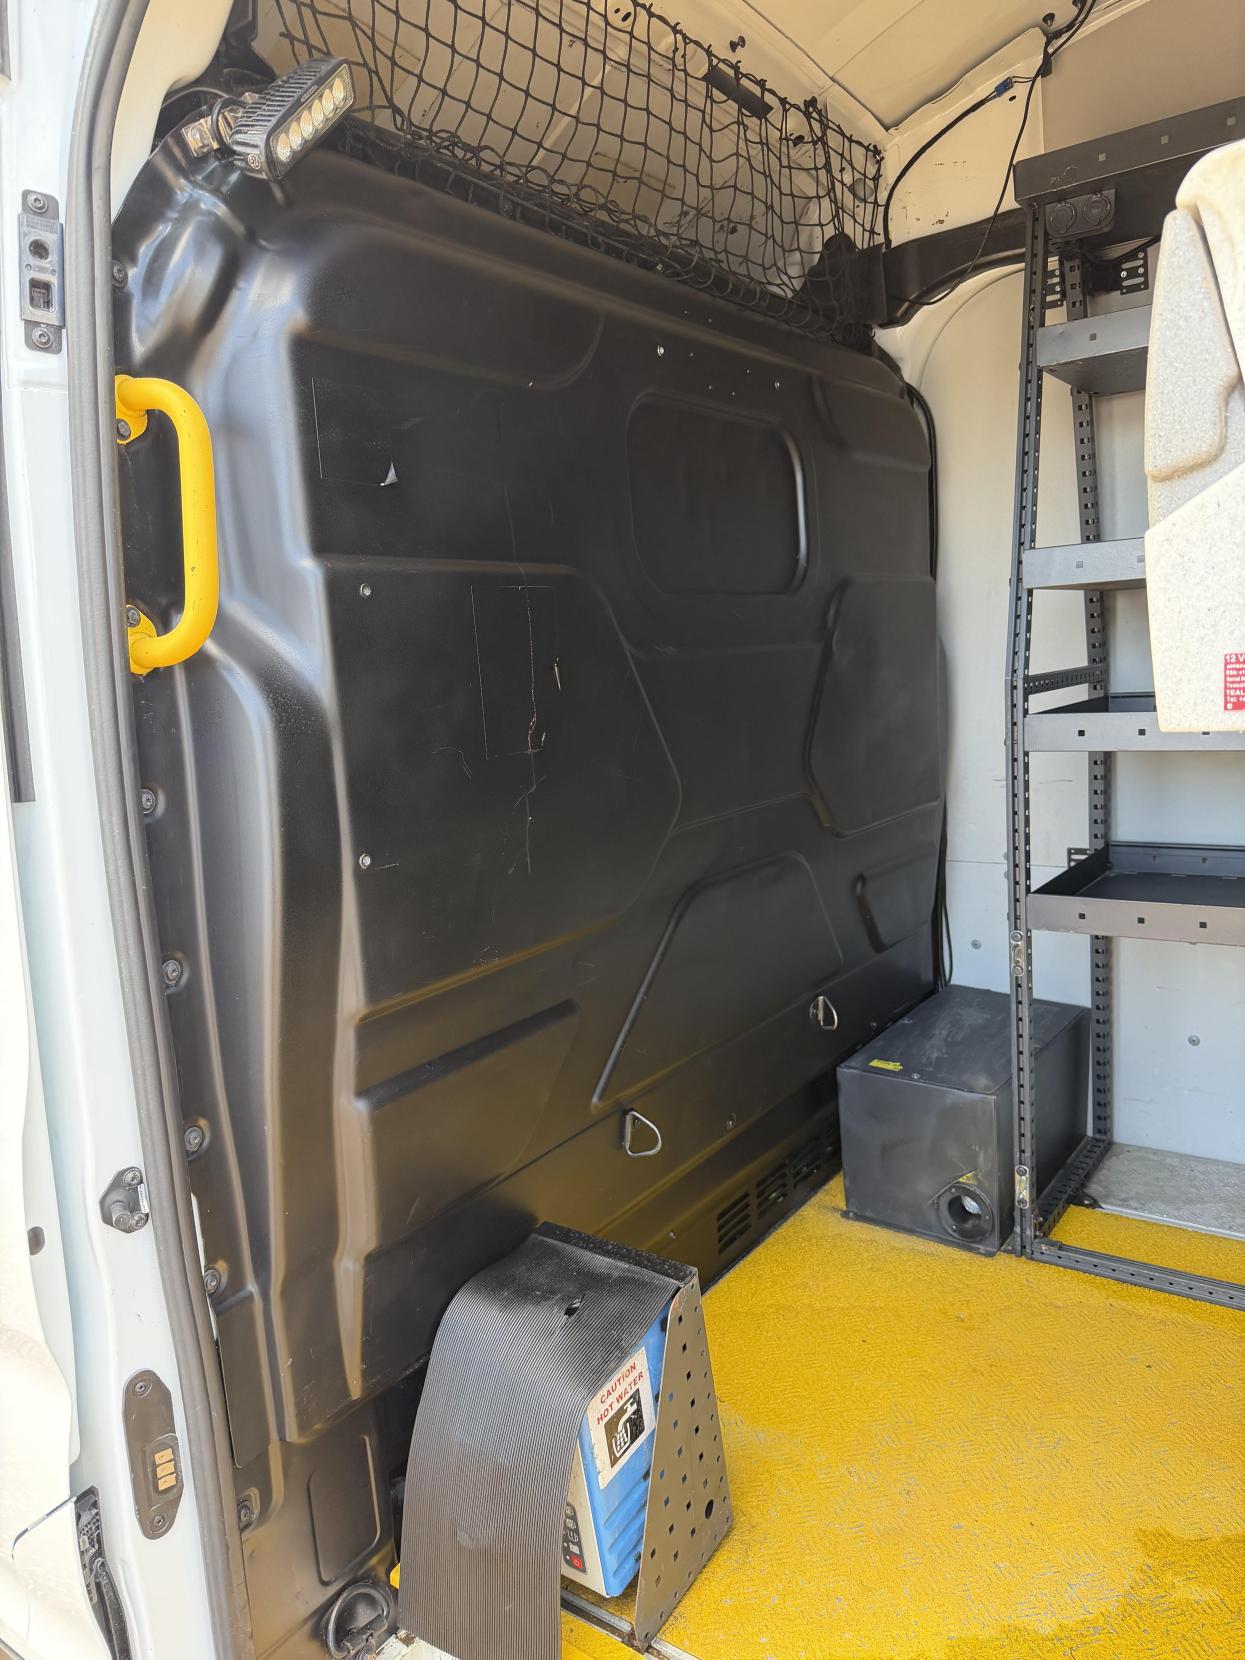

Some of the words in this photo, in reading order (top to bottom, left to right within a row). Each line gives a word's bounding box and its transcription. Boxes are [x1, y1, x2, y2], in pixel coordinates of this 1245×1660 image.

[1225, 654, 1236, 662] 12
[596, 1401, 615, 1425] HOT
[615, 1371, 644, 1404] WATER
[600, 1361, 637, 1404] CAUTION
